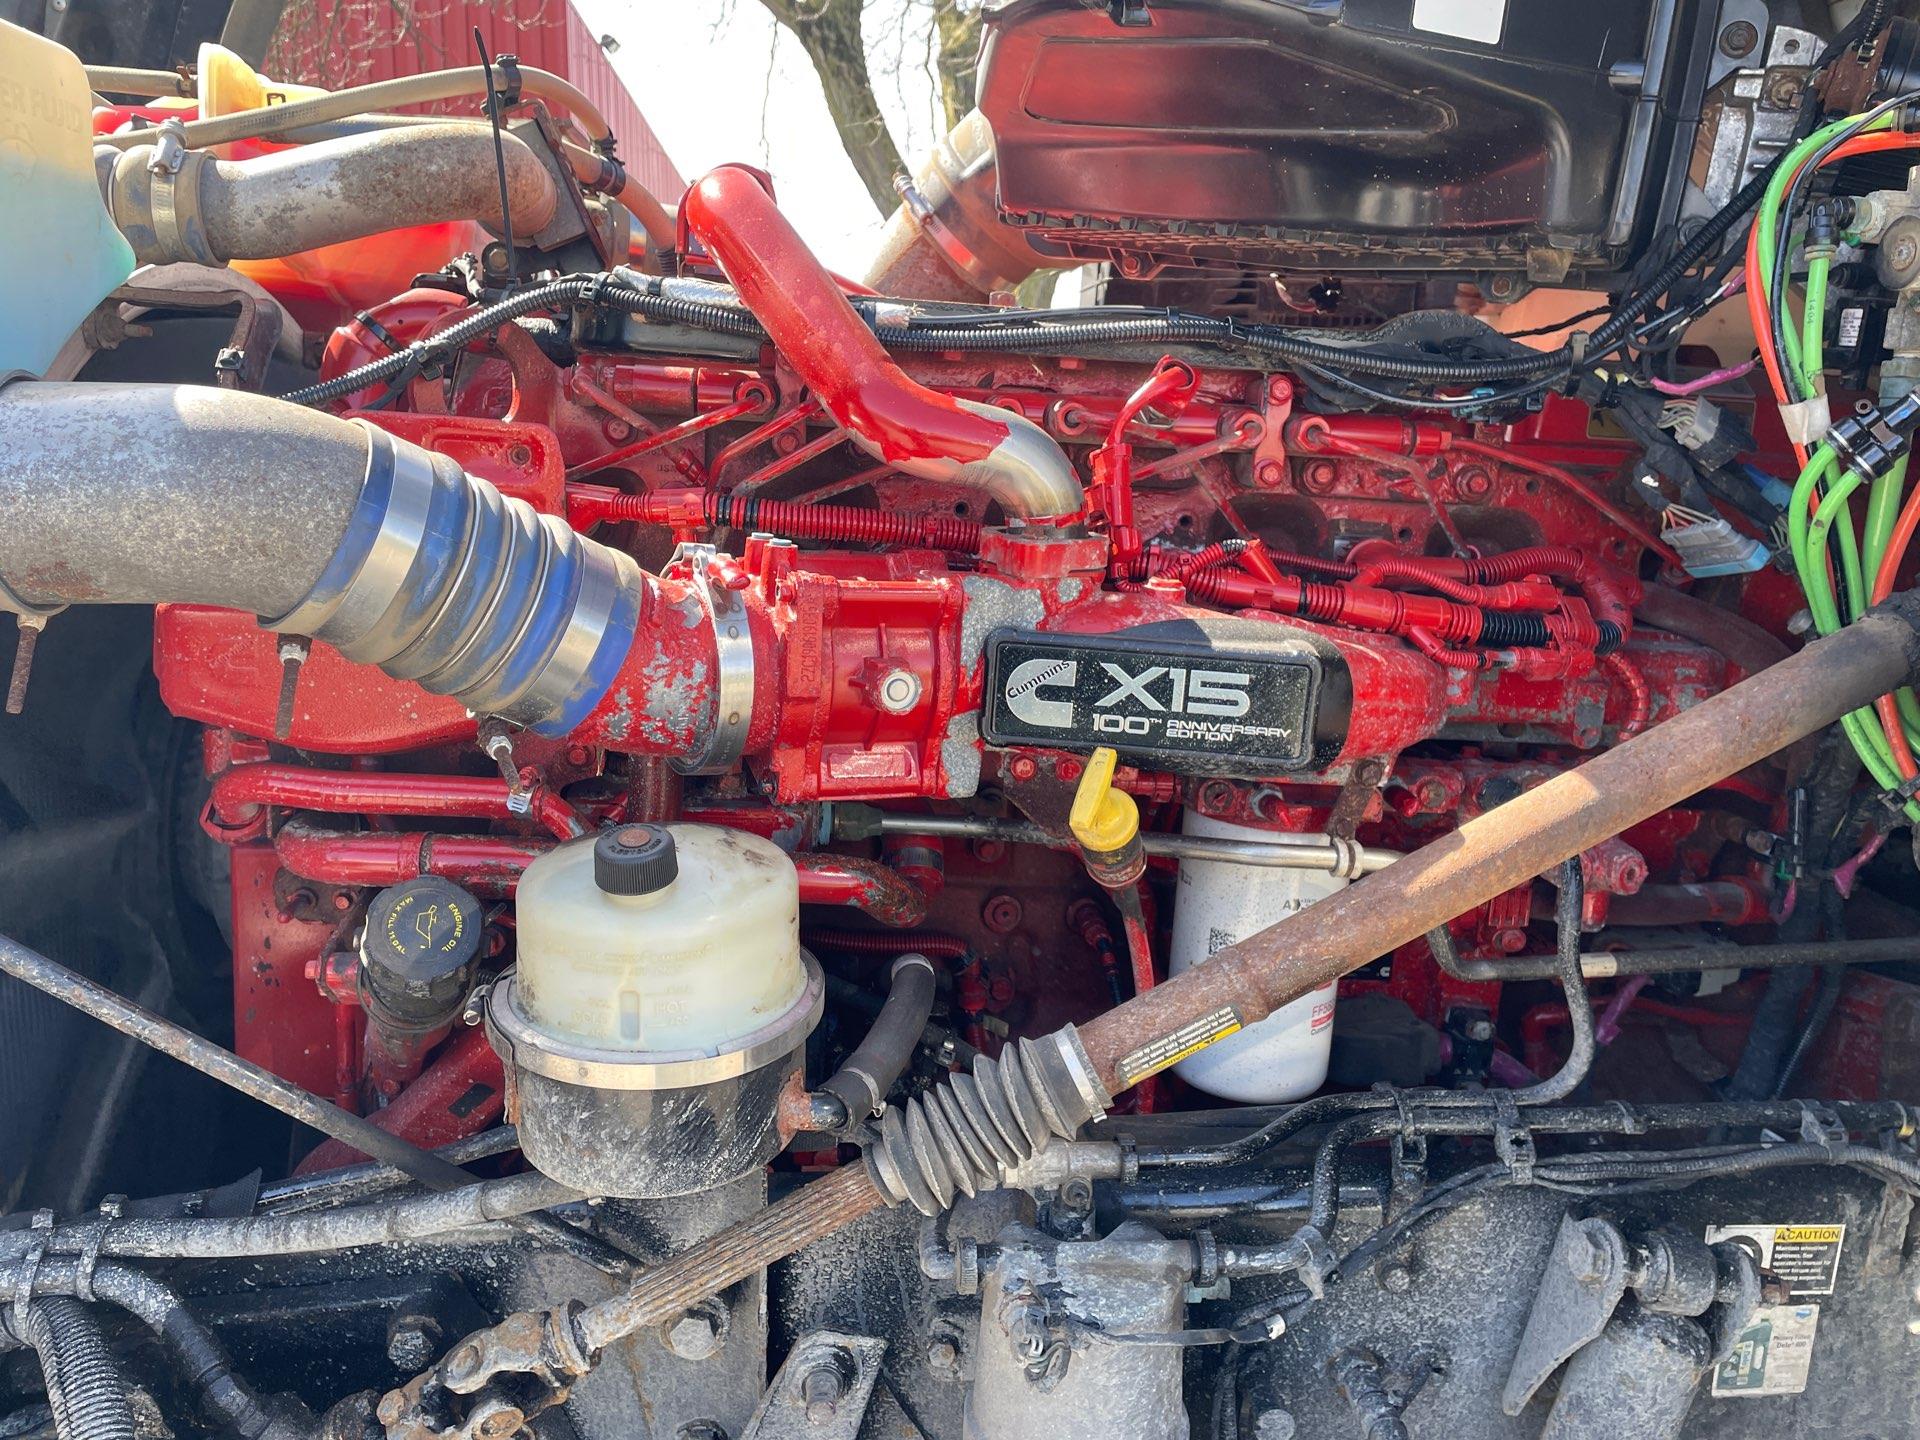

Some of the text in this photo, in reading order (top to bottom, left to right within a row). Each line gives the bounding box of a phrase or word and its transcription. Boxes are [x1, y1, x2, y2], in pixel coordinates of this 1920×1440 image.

[1007, 661, 1070, 699] Cummins
[1093, 662, 1251, 717] X15
[1165, 728, 1233, 742] EDITION
[1167, 719, 1292, 738] ANNIVERSARY
[395, 896, 414, 912] MAX
[387, 912, 397, 929] FILL
[441, 903, 463, 952] ENGINE OIL
[391, 939, 406, 955] GAL
[655, 1000, 688, 1016] HOT
[1787, 1230, 1840, 1240] CAUTION
